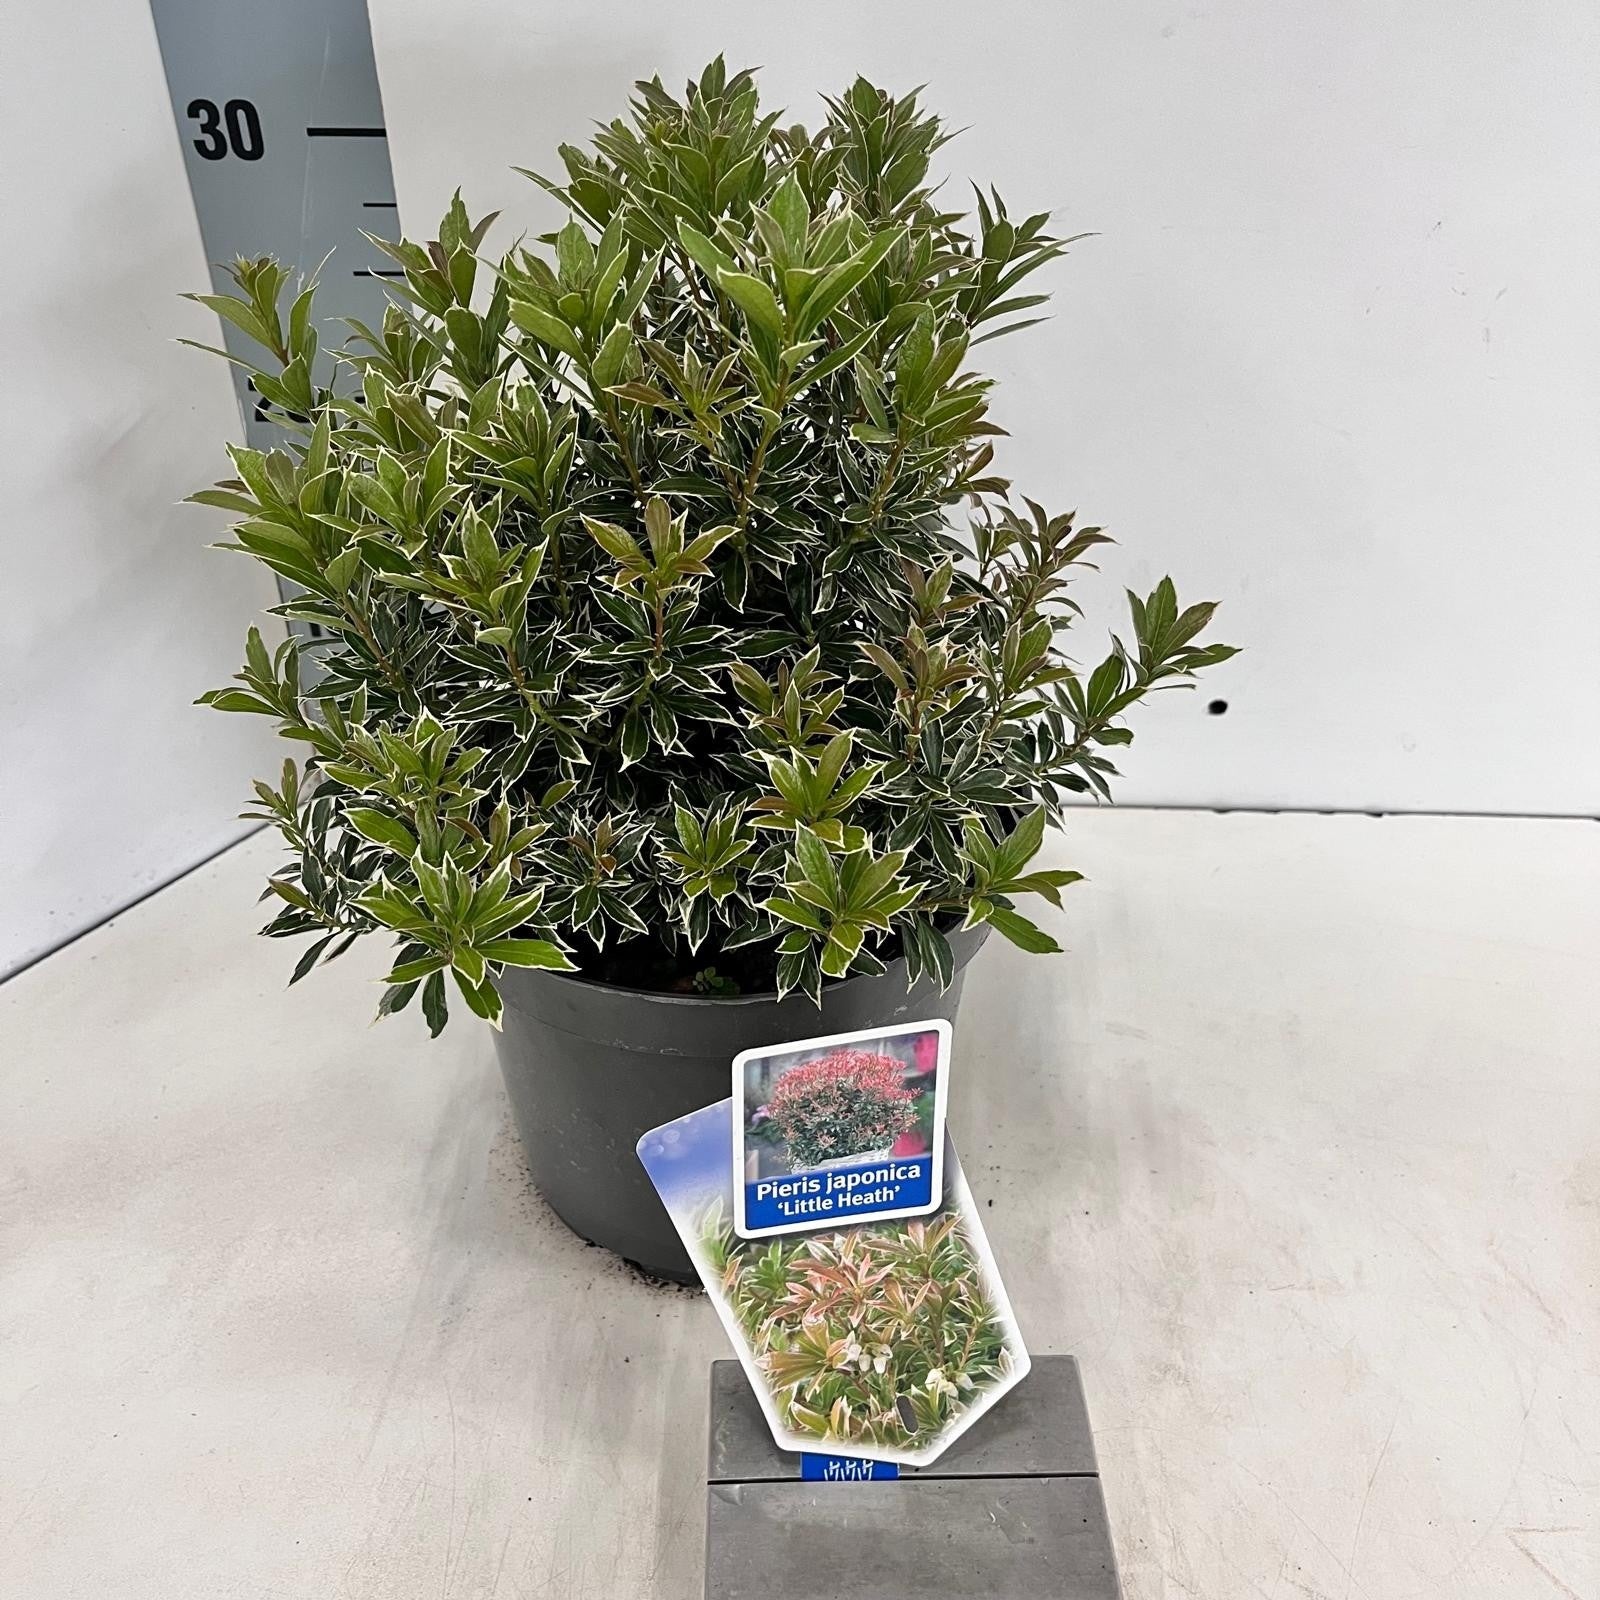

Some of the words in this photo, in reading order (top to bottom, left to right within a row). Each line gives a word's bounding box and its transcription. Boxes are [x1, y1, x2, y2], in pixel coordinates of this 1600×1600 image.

[187, 98, 265, 162] 30
[757, 1176, 821, 1201] Pieris
[826, 1163, 921, 1194] japonica
[778, 1196, 833, 1216] ‘Little
[838, 1185, 900, 1208] Heath’
